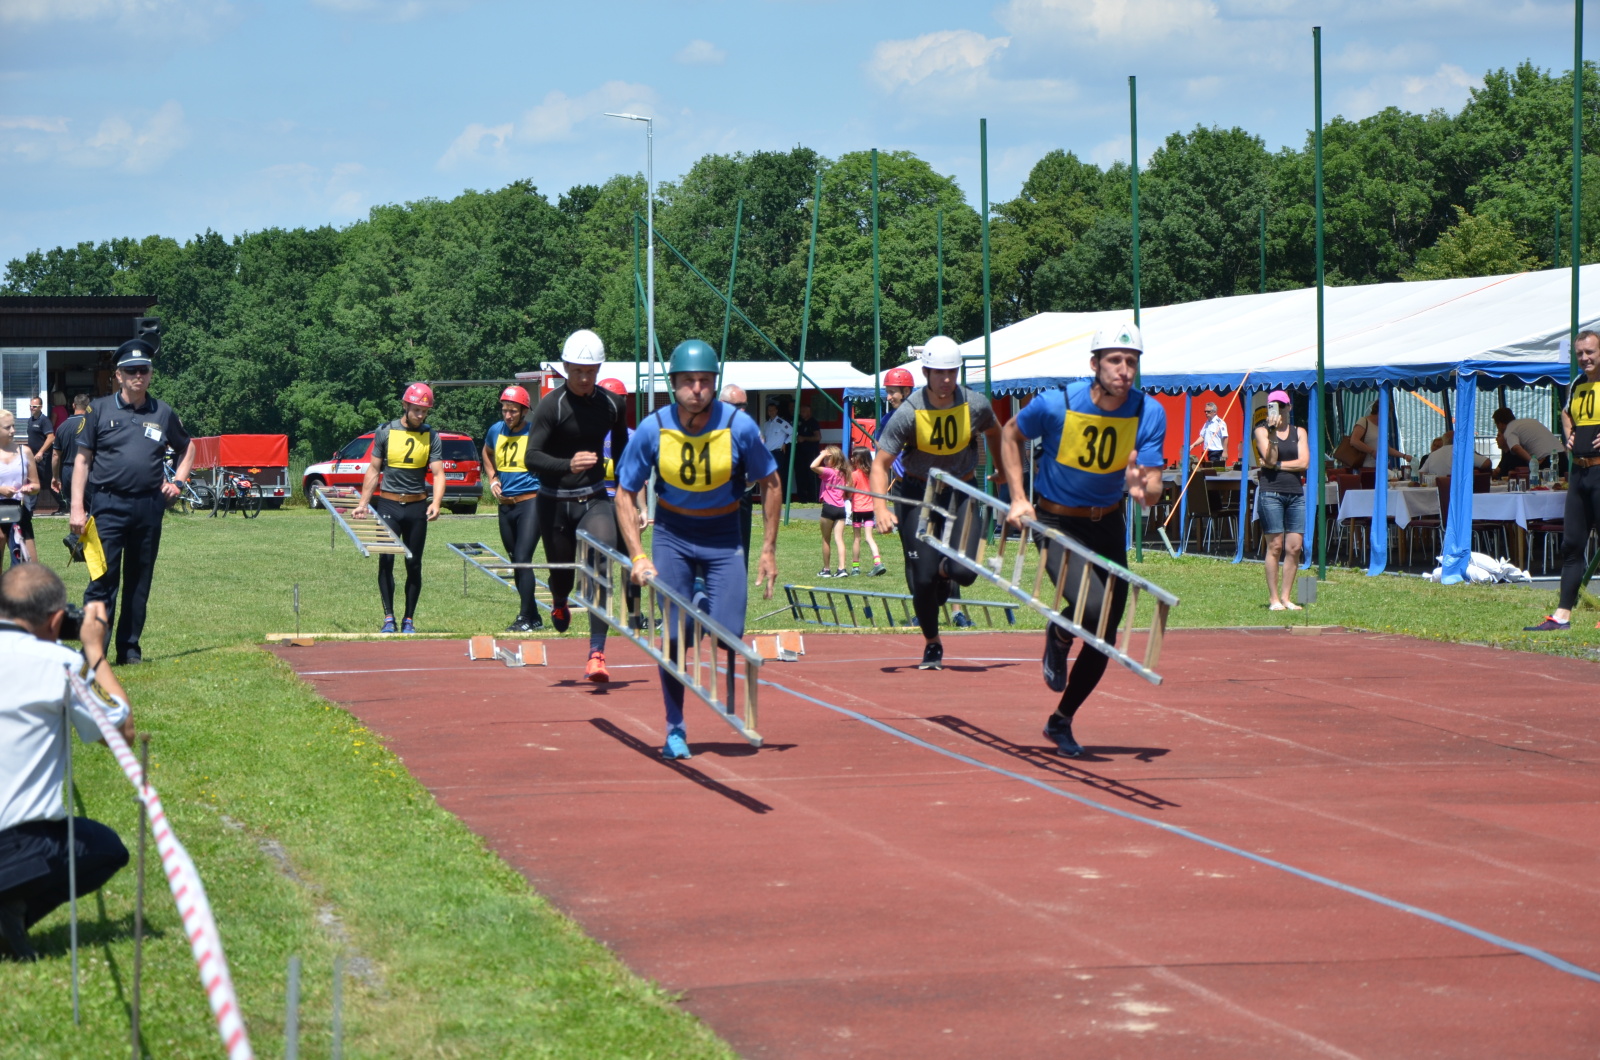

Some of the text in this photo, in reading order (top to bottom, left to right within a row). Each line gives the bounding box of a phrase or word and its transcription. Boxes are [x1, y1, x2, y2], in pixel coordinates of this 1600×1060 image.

[1578, 390, 1594, 419] 70
[930, 415, 958, 450] 40
[1078, 426, 1117, 470] 30
[404, 438, 415, 463] 2
[502, 441, 518, 467] 12
[679, 442, 711, 486] 81
